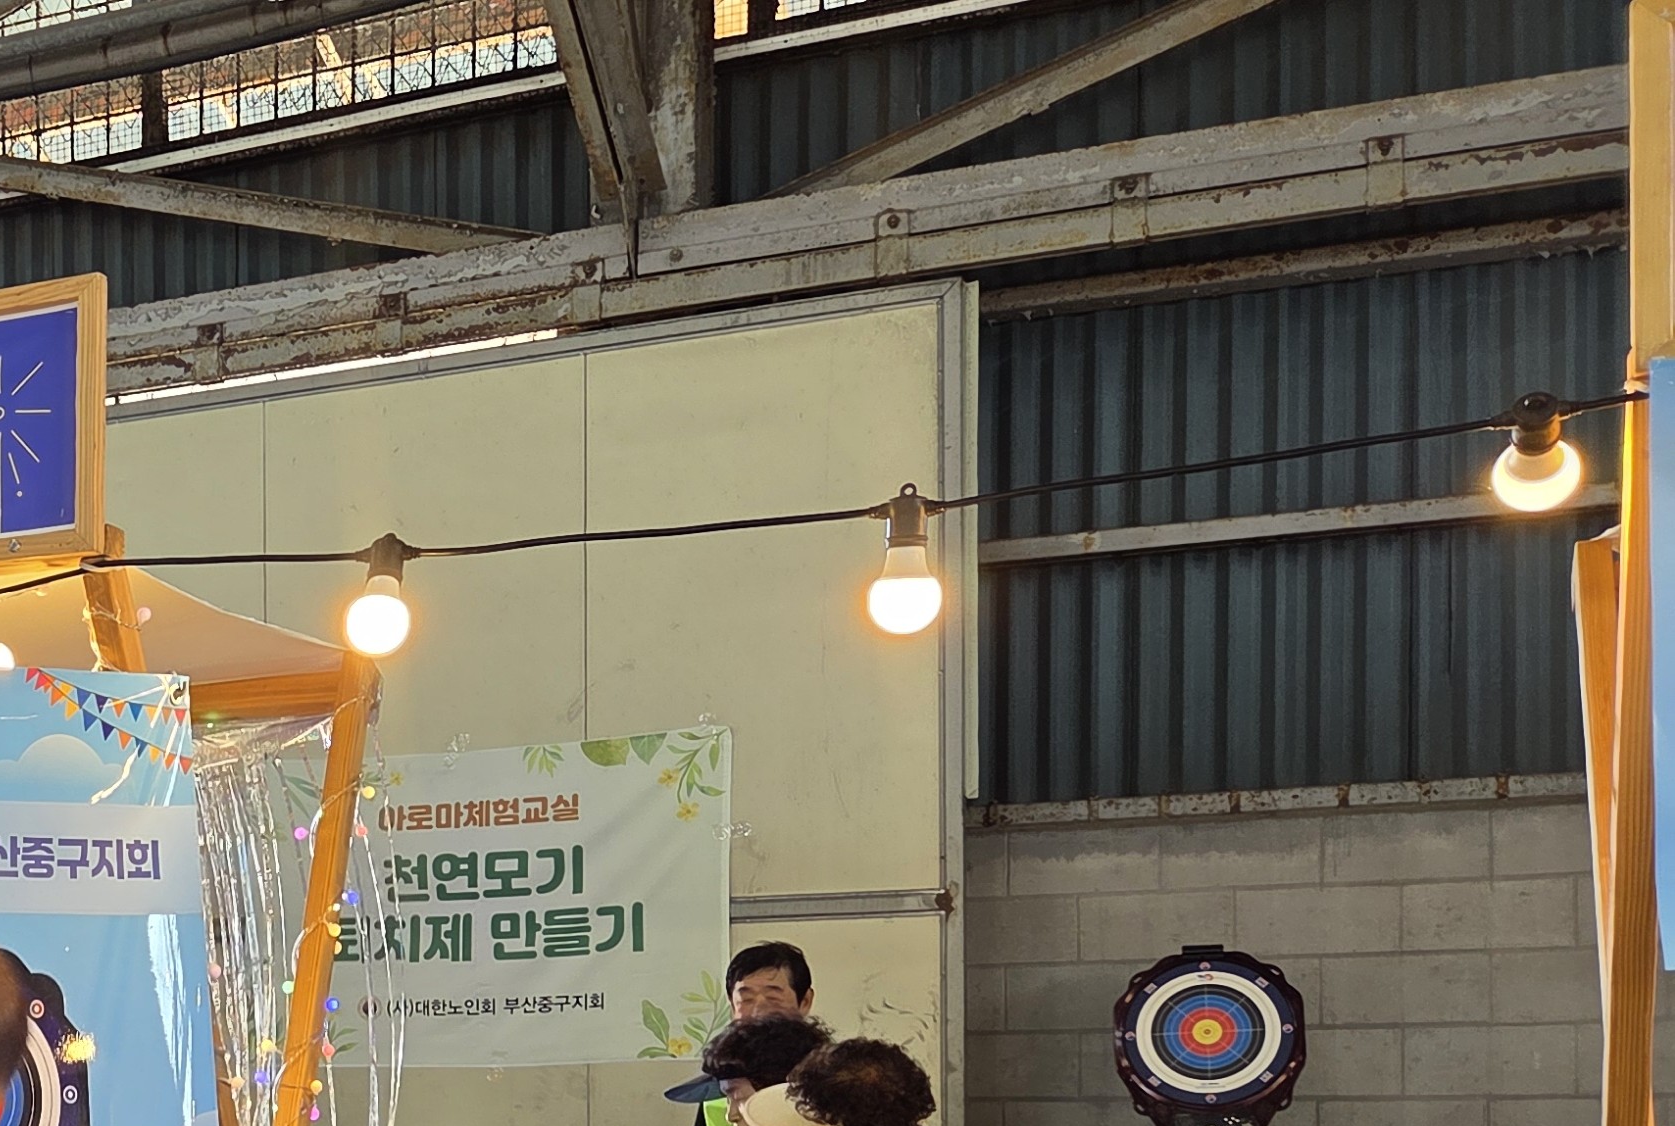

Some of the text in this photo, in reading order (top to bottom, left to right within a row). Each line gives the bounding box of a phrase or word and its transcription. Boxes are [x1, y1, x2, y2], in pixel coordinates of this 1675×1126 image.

[378, 793, 580, 831] 아로마체험교실
[383, 844, 584, 902] 천연모기
[490, 901, 645, 961] 만들기
[386, 992, 605, 1017] (사)대한노인회 부산중구지회
